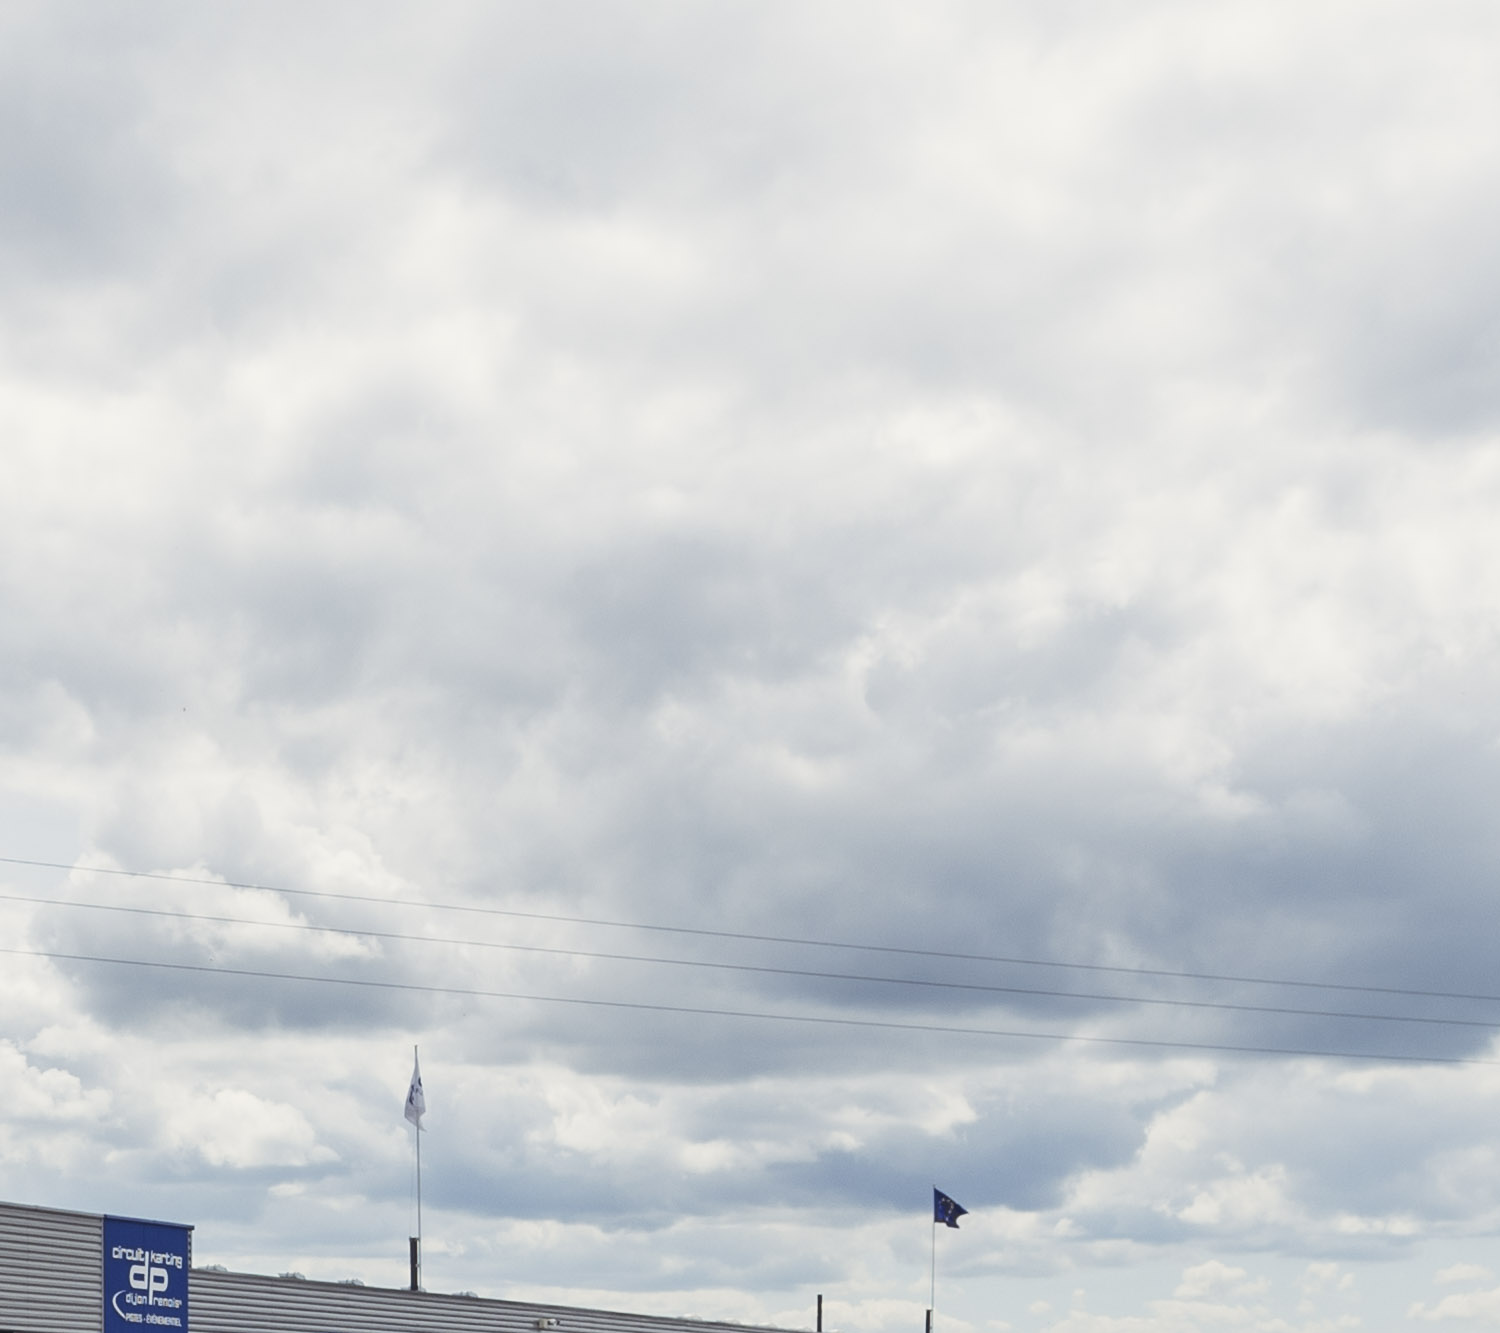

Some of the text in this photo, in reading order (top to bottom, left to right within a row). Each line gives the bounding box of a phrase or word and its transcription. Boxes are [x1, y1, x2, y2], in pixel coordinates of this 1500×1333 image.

[112, 1245, 183, 1269] circuit karting
[125, 1291, 148, 1306] dijon
